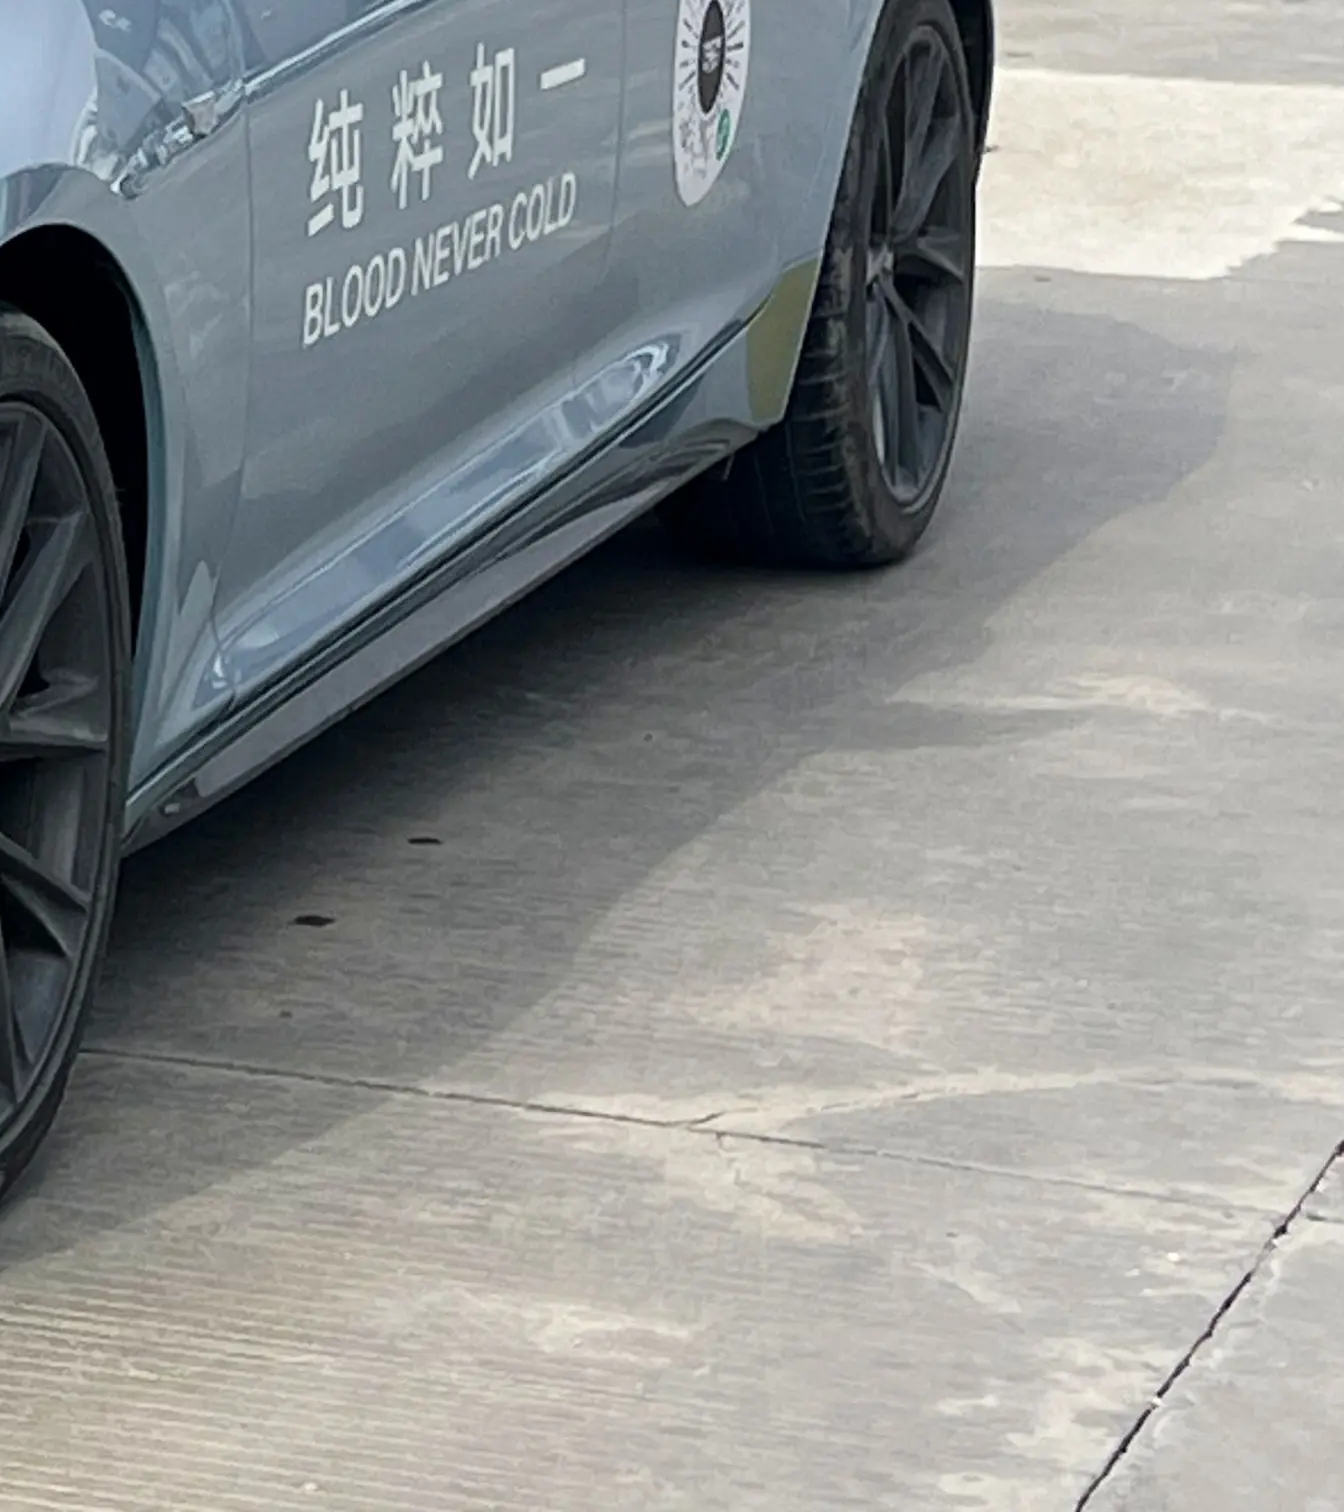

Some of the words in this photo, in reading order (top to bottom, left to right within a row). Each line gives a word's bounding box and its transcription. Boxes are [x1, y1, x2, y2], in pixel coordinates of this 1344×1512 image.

[307, 42, 586, 236] 纯粹如一
[302, 247, 406, 347] BLOOD
[411, 204, 503, 296] NEVER
[508, 172, 577, 250] COLD
